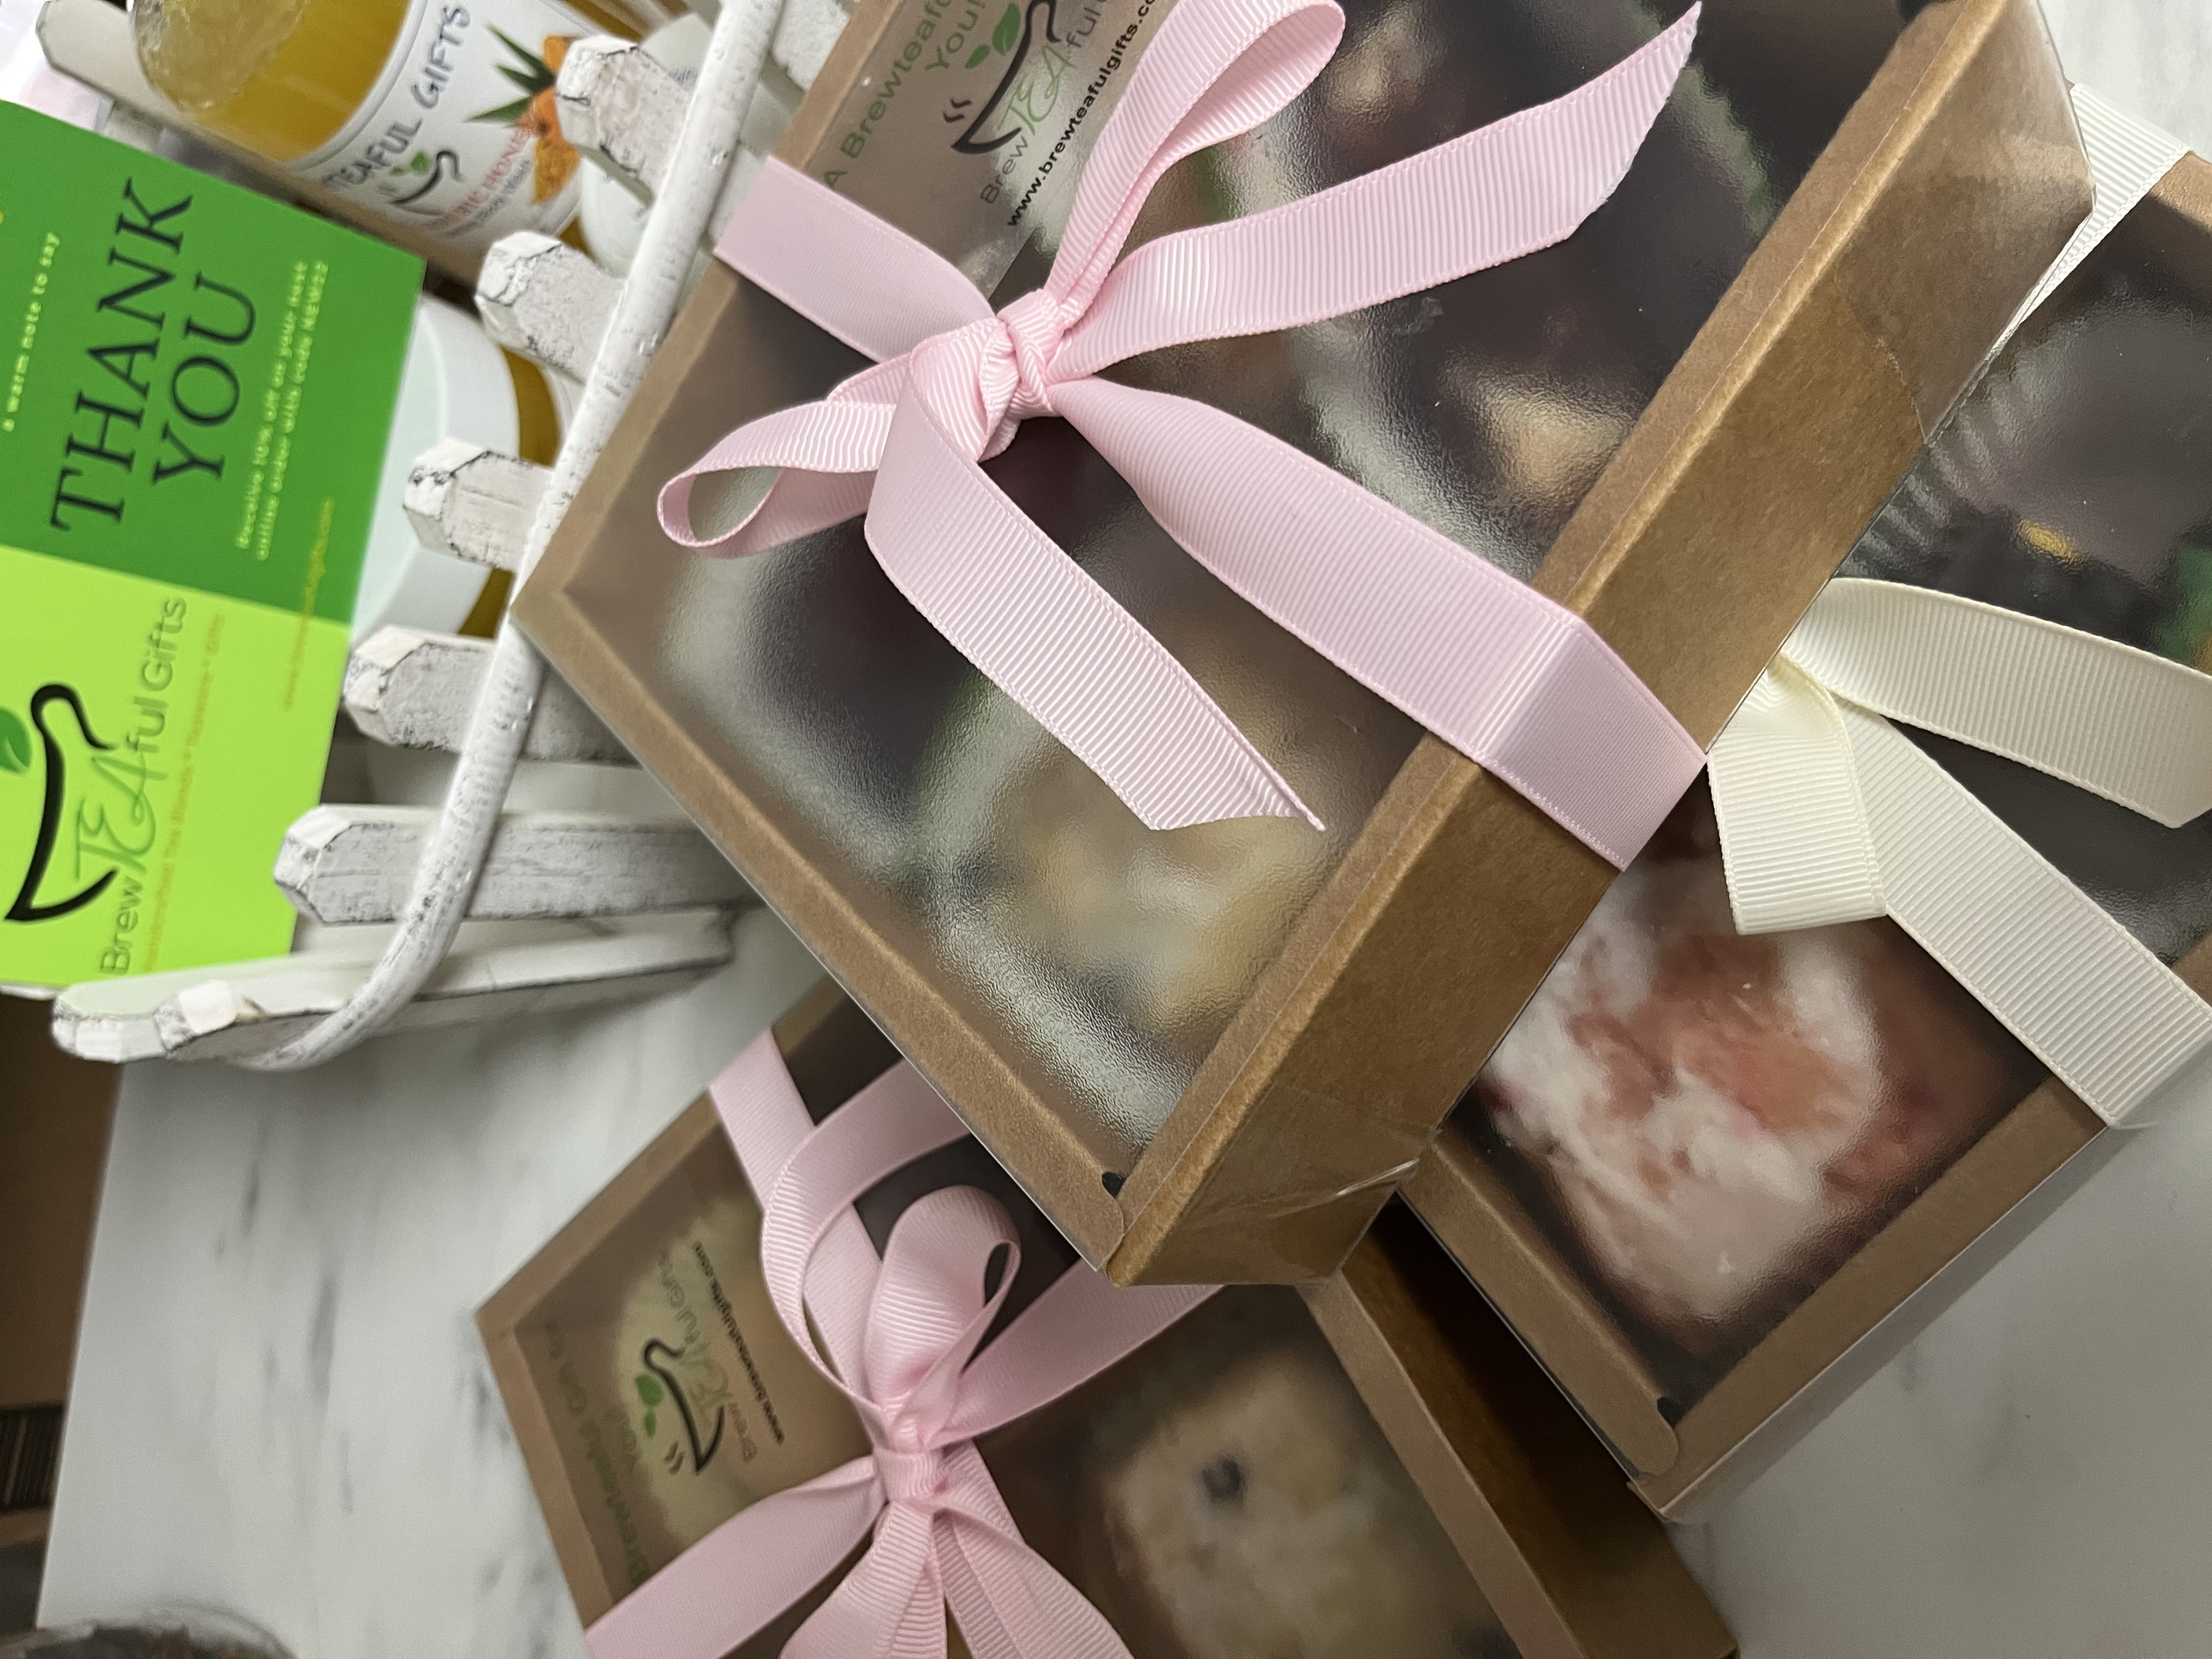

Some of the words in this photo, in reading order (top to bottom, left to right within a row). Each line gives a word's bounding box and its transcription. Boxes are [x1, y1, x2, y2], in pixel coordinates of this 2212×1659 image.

[411, 4, 471, 110] GIFTS
[40, 231, 60, 268] say
[32, 272, 48, 295] to
[21, 301, 42, 349] note
[49, 176, 194, 532] THANK
[6, 354, 30, 413] warm
[151, 270, 256, 486] YOU
[2, 418, 15, 432] a
[140, 596, 187, 692] Gifts
